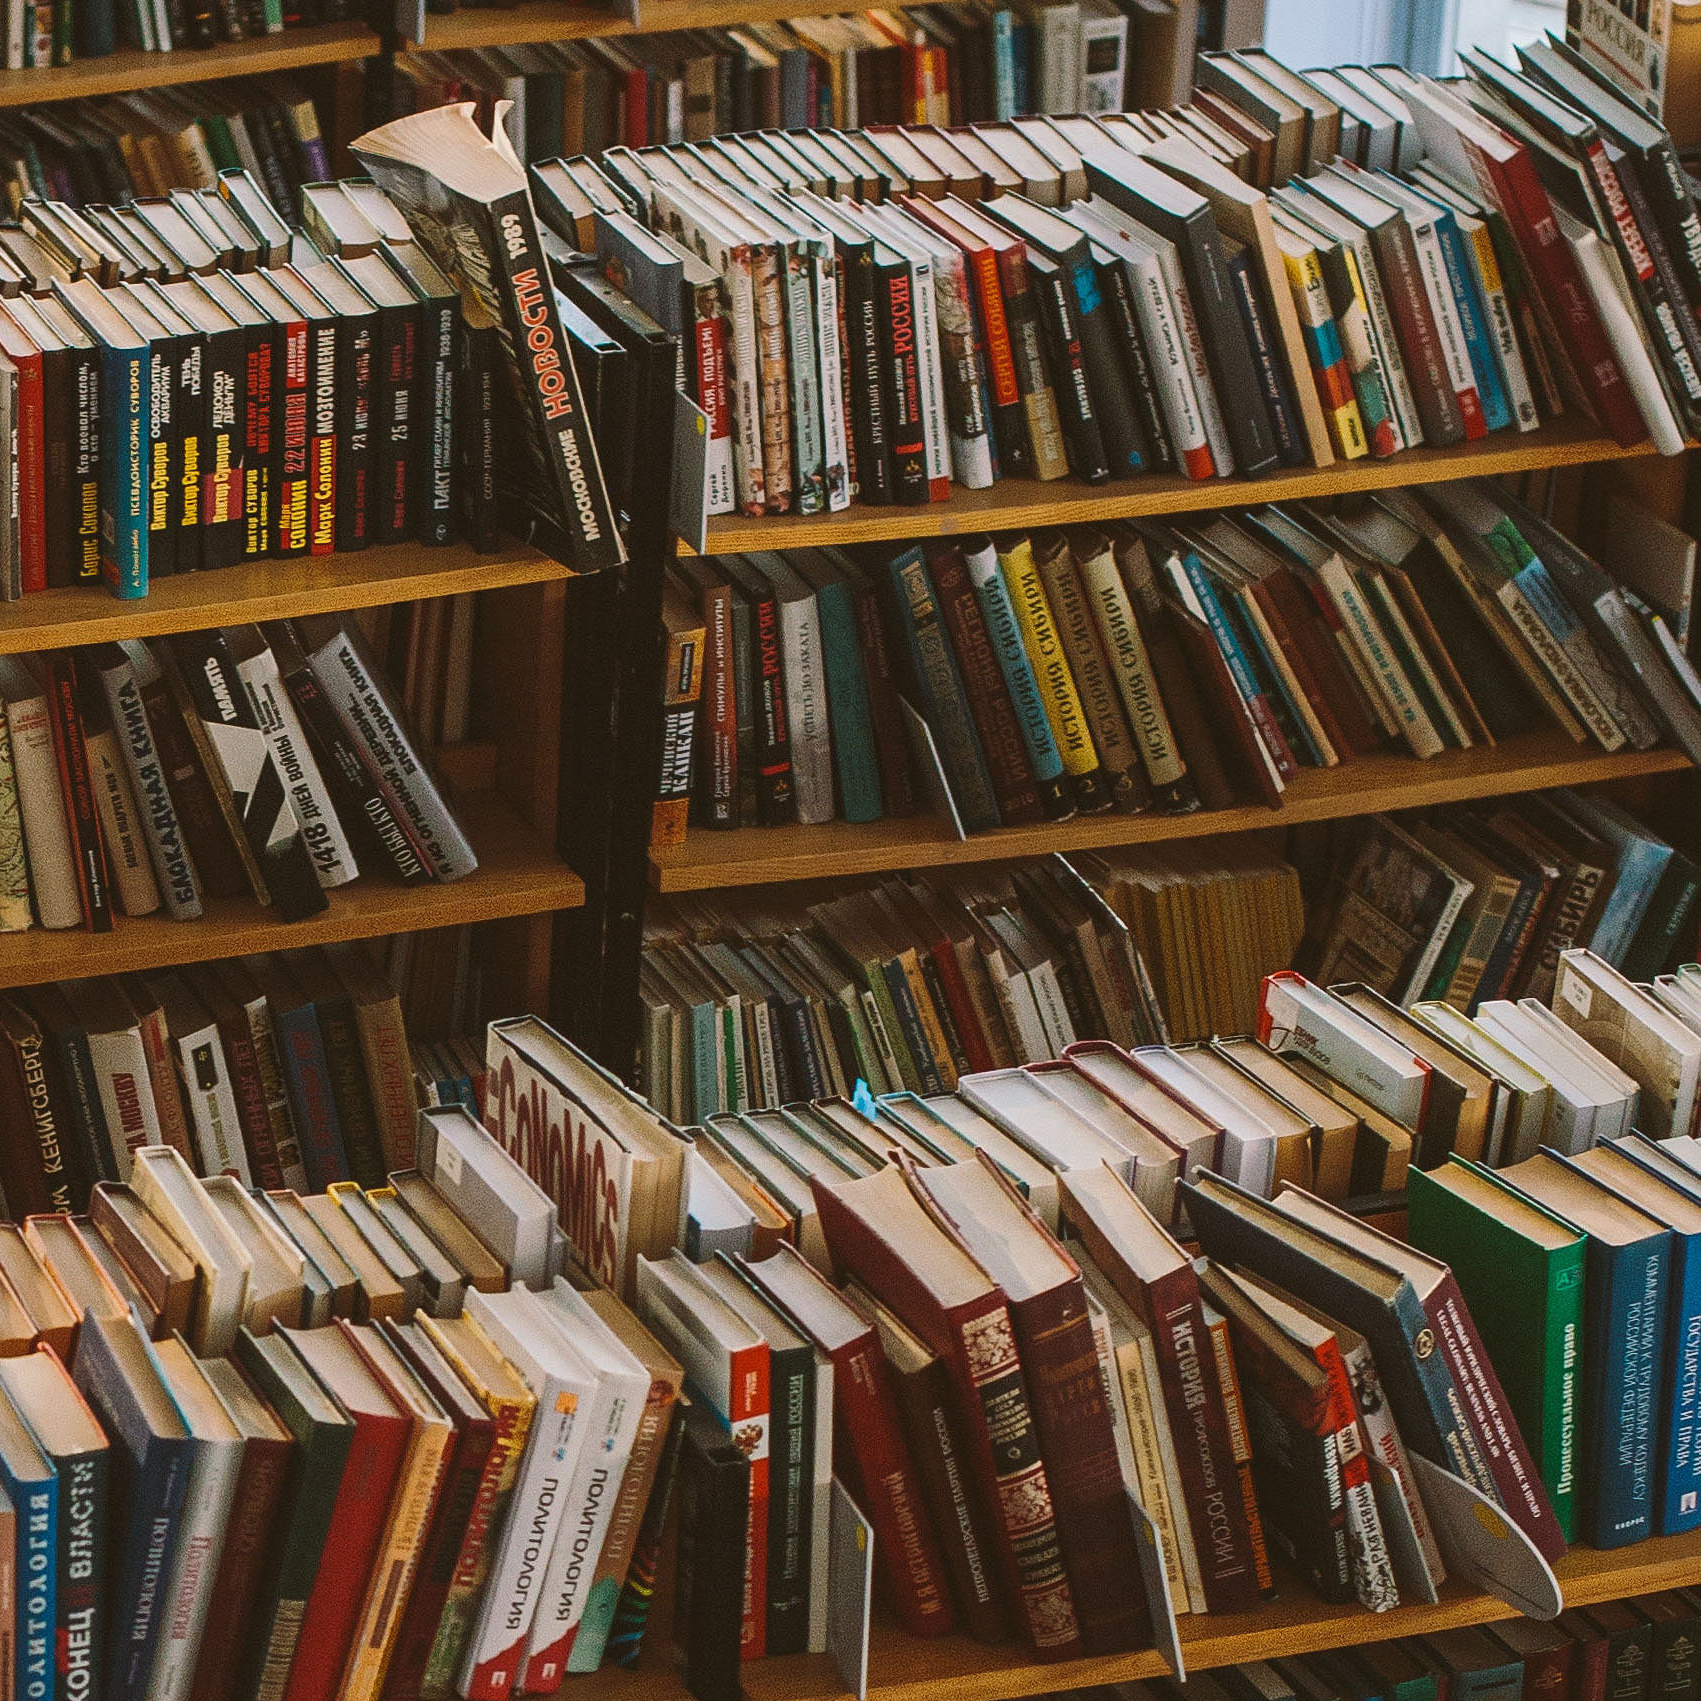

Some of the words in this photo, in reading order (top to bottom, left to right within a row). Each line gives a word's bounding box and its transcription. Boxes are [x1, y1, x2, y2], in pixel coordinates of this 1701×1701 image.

[499, 213, 528, 261] 1989
[512, 268, 572, 418] НОВОСТИ
[863, 300, 876, 346] РОССИИ
[889, 276, 912, 354] РОССИИ
[130, 360, 140, 412] СУВОРОВ
[317, 328, 335, 433] МОЗГОИМЕНИЕ
[865, 350, 878, 379] ПУТЬ
[867, 383, 882, 443] КРЕСТНЫЙ
[131, 418, 140, 516] ПСЕВДОИСТОРИК
[153, 442, 169, 490] Суворов
[183, 436, 199, 485] Суворов
[215, 434, 232, 482] Суворов
[316, 438, 334, 499] Солонин
[559, 429, 601, 541] МОСКОВСКИЕ
[151, 490, 168, 530] Виктор
[181, 486, 199, 526] Виктор
[213, 483, 230, 523] Виктор
[316, 502, 333, 544] Марк
[758, 601, 779, 676] РОССИИ
[983, 578, 1021, 661] СИБИРИ
[1019, 572, 1055, 655] СИБИРИ
[1055, 574, 1093, 656] СИБИРИ
[1100, 587, 1137, 667] СИБИРИ
[204, 658, 237, 721] ПАМЯТЬ
[338, 646, 377, 693] КНИГА
[118, 679, 153, 757] КНИГА
[363, 694, 418, 773] БЛОКАДНАЯ
[1019, 669, 1052, 756] ИСТОРИЯ
[1047, 663, 1083, 751] ИСТОРИЯ
[1082, 664, 1120, 747] ИСТОРИЯ
[1127, 674, 1169, 760] ИСТОРИЯ
[273, 734, 305, 780] ВОЙНЫ
[659, 712, 680, 794] ЧЕЧЕНСКИЙ
[672, 710, 696, 792] КАПКАН
[143, 761, 194, 904] БЛОКАДНАЯ
[292, 782, 322, 818] ДНЕЙ
[305, 823, 341, 874] 1418
[1638, 1255, 1659, 1349] КОММЕНТАРИЙ
[1562, 1323, 1577, 1368] право
[1640, 1353, 1652, 1362] К
[932, 1408, 957, 1455] РОССИИ
[1557, 1372, 1574, 1495] Процессуальное
[1636, 1365, 1652, 1440] ТРУДОВОМУ
[1681, 1411, 1695, 1420] И
[945, 1457, 966, 1503] ПАРТИИ
[1632, 1444, 1648, 1500] КОДЕКСУ
[1675, 1426, 1692, 1468] ПРАВА
[69, 1462, 95, 1579] ВЛАСТИ
[504, 1478, 559, 1630] ПОЛИТОЛОГИЯ
[554, 1469, 609, 1621] ПОЛИТОЛОГИЯ
